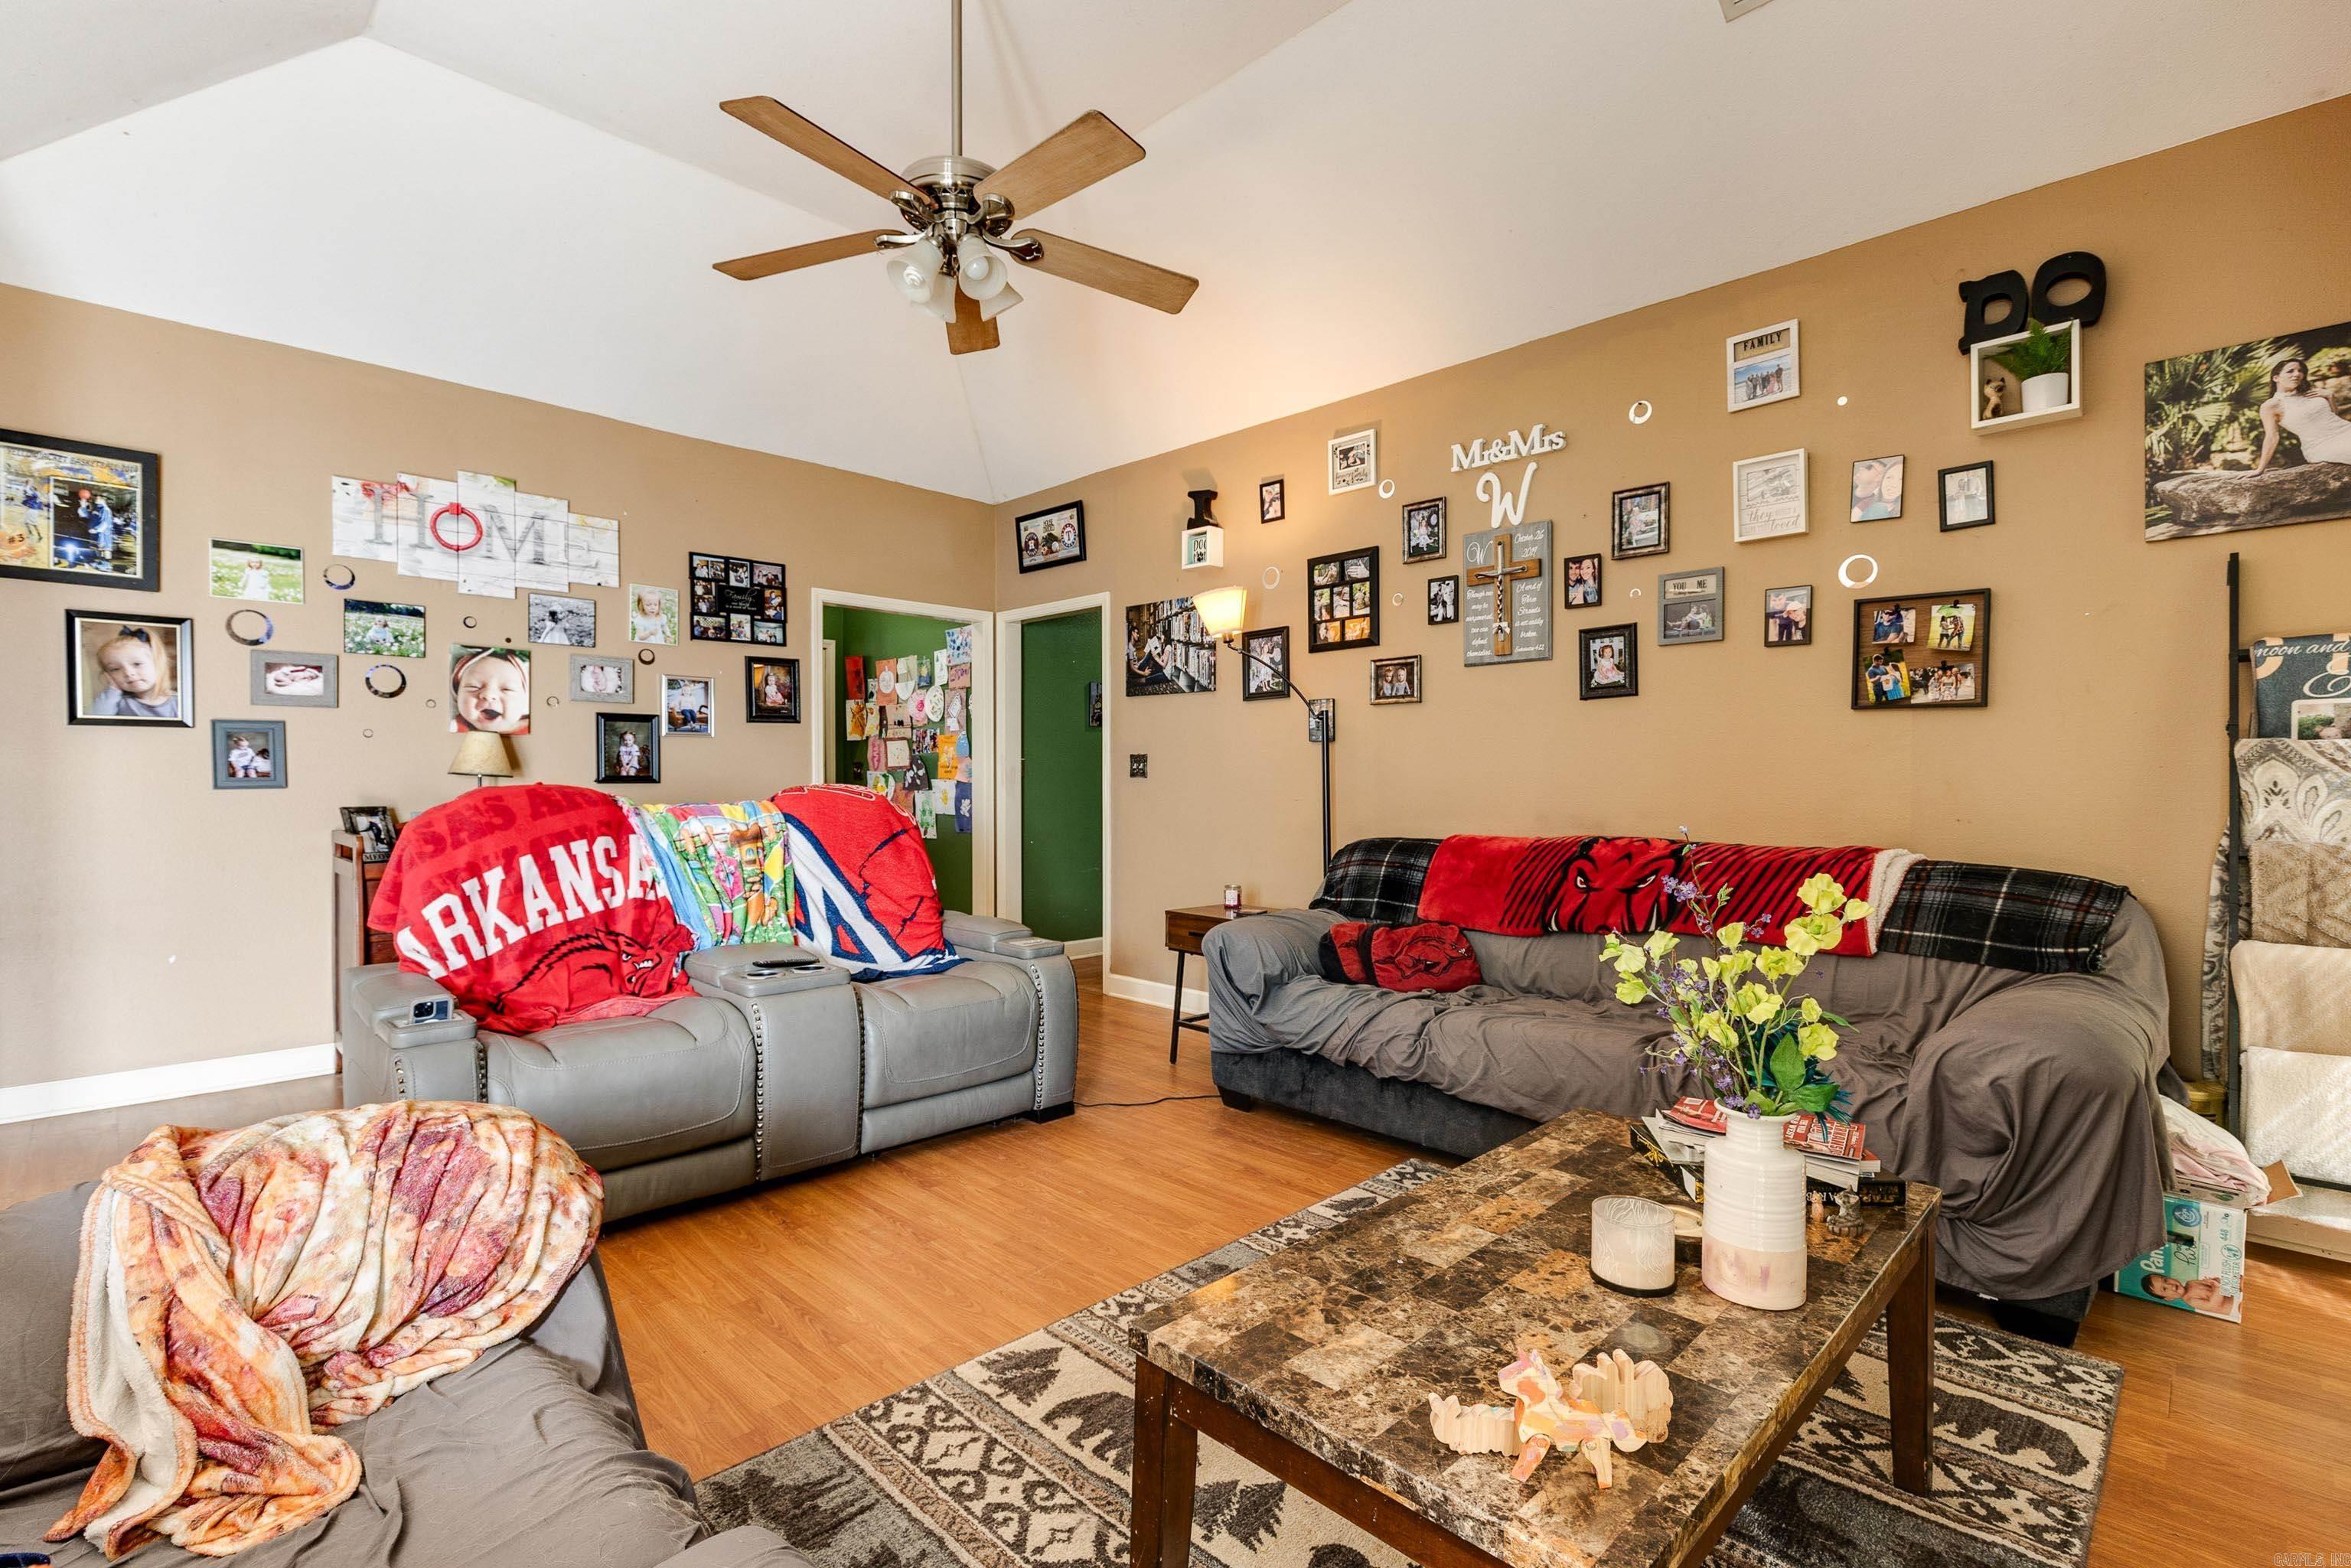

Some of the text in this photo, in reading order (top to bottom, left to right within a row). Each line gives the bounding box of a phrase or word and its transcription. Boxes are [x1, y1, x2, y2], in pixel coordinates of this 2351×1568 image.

[1958, 251, 2106, 356] DO
[1743, 331, 1782, 351] FAMILY
[1476, 461, 1538, 528] W
[8, 533, 26, 544] #3
[364, 486, 602, 570] HOME
[1466, 540, 1494, 565] W
[1673, 579, 1707, 591] YOU ME
[2254, 640, 2351, 657] moon and
[396, 833, 670, 980] ARKANSA
[1785, 1124, 1796, 1139] WEST
[2140, 1244, 2169, 1273] Pam
